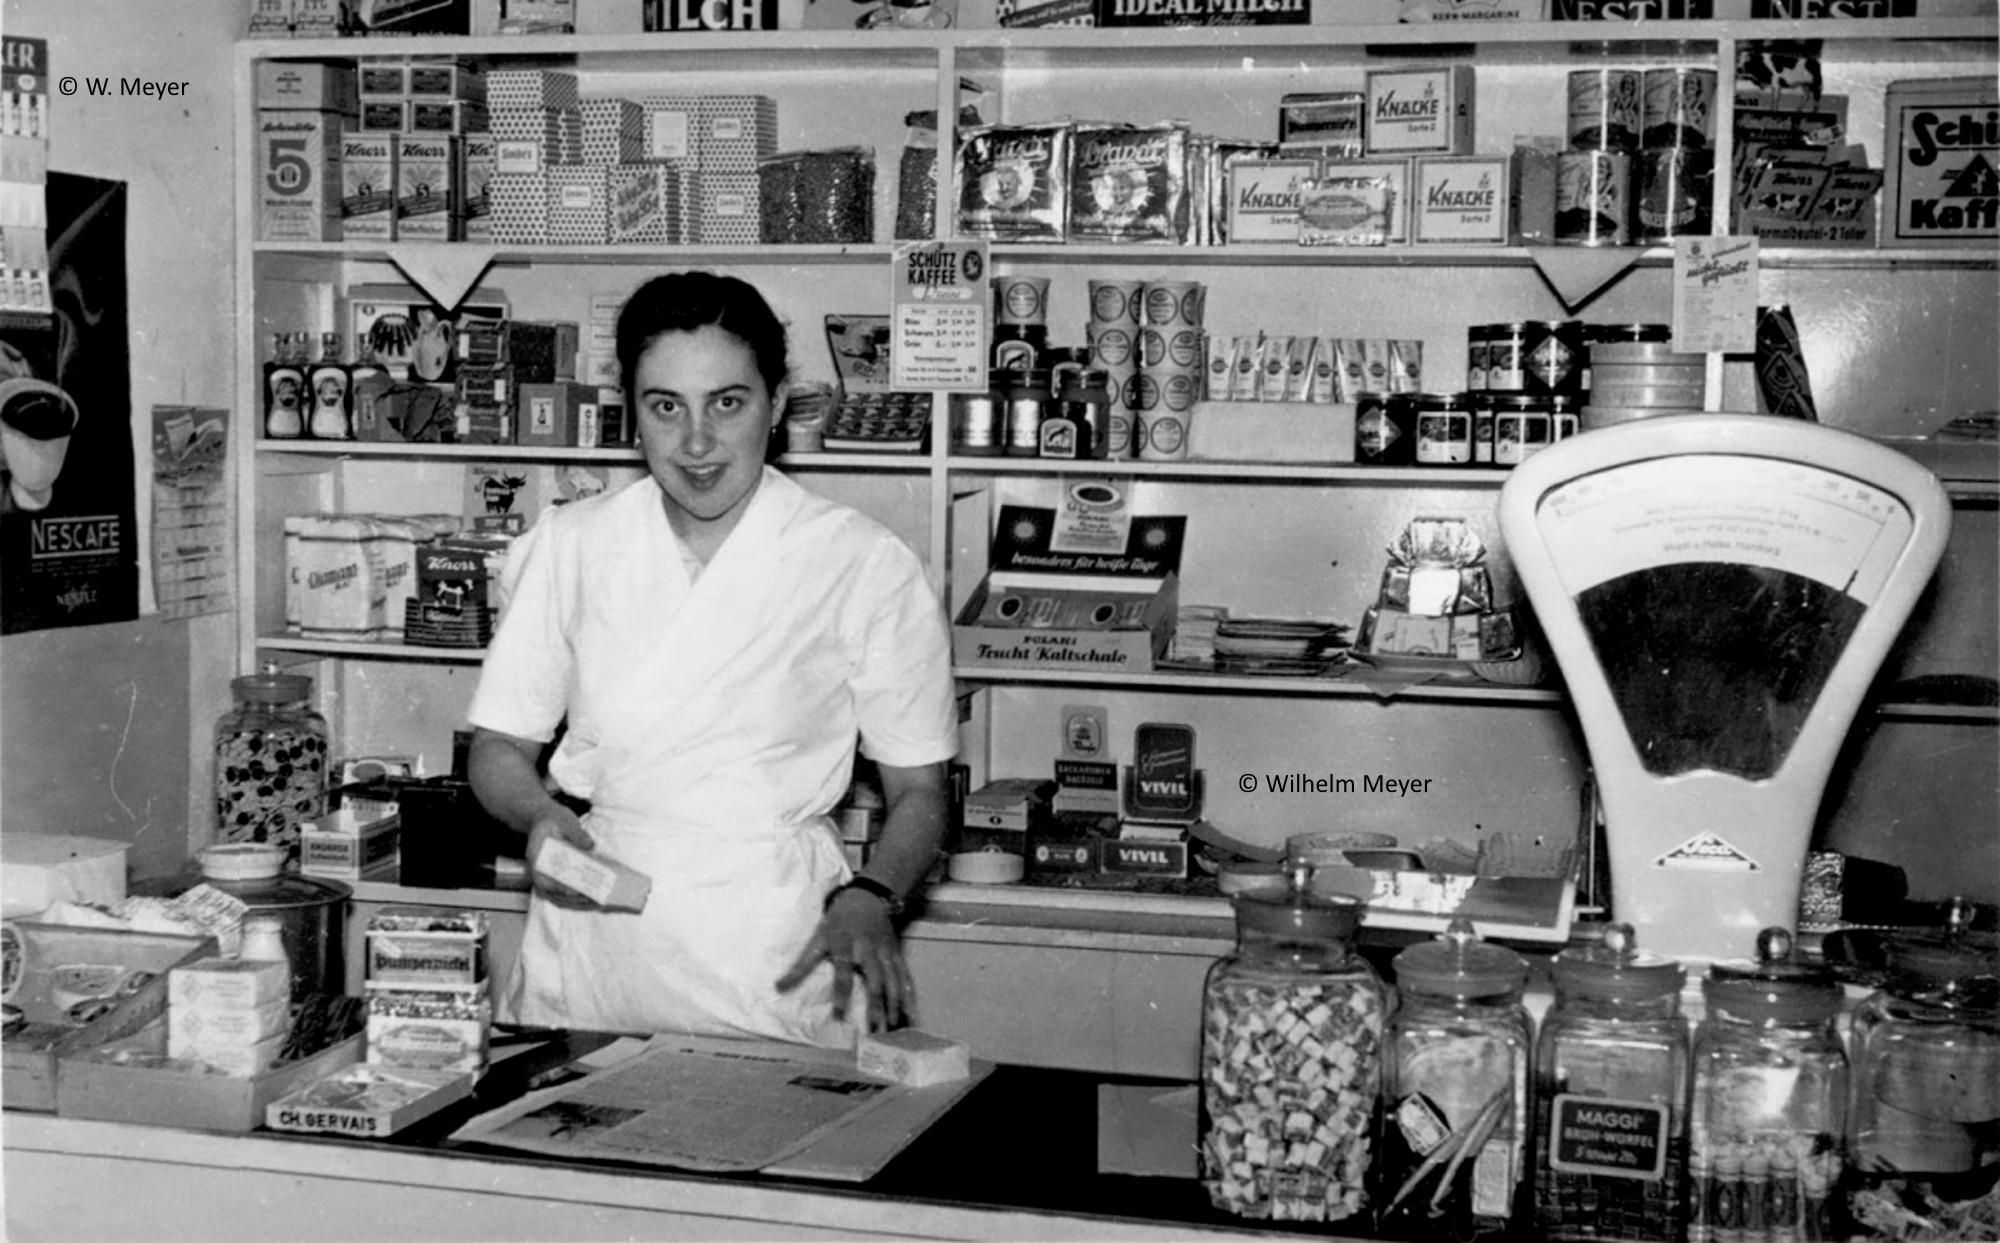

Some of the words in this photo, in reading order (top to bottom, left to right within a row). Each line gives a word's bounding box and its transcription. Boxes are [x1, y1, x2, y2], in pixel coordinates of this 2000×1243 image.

[267, 139, 311, 196] 5
[907, 269, 957, 285] KAFFEE
[427, 556, 478, 571] Knorr
[1011, 551, 1072, 568] besonders
[1074, 555, 1093, 569] für
[976, 644, 1029, 660] Frucht
[1035, 645, 1127, 664] Kaltschale
[1140, 781, 1188, 796] VIVIL
[1118, 849, 1169, 864] VIVIL
[305, 1113, 377, 1131] GERVAIS
